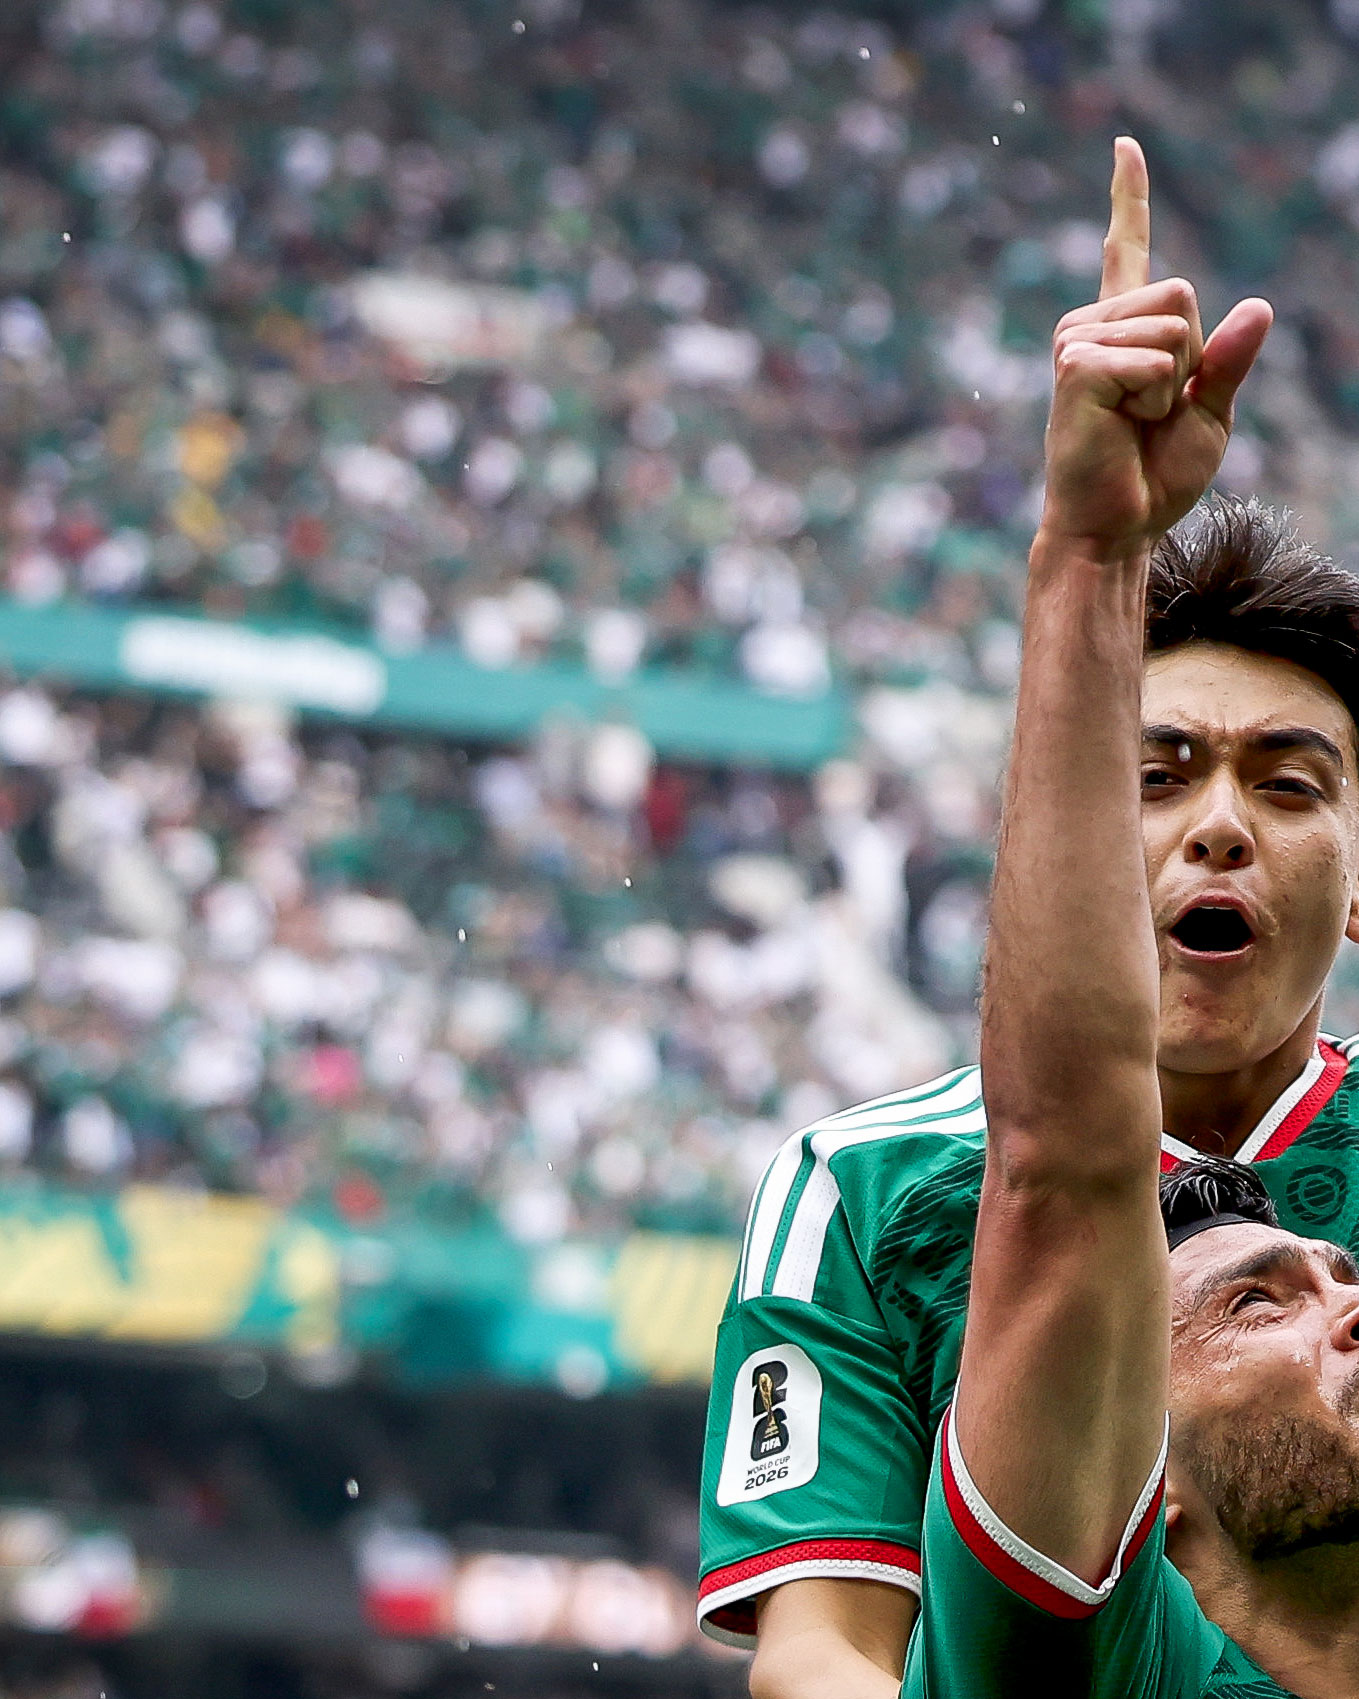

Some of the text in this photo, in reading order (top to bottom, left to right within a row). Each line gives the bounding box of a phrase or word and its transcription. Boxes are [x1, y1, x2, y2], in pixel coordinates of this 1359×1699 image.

[760, 1438, 782, 1453] FIFA
[747, 1455, 791, 1476] WORLD CUP
[744, 1466, 789, 1491] 2026
